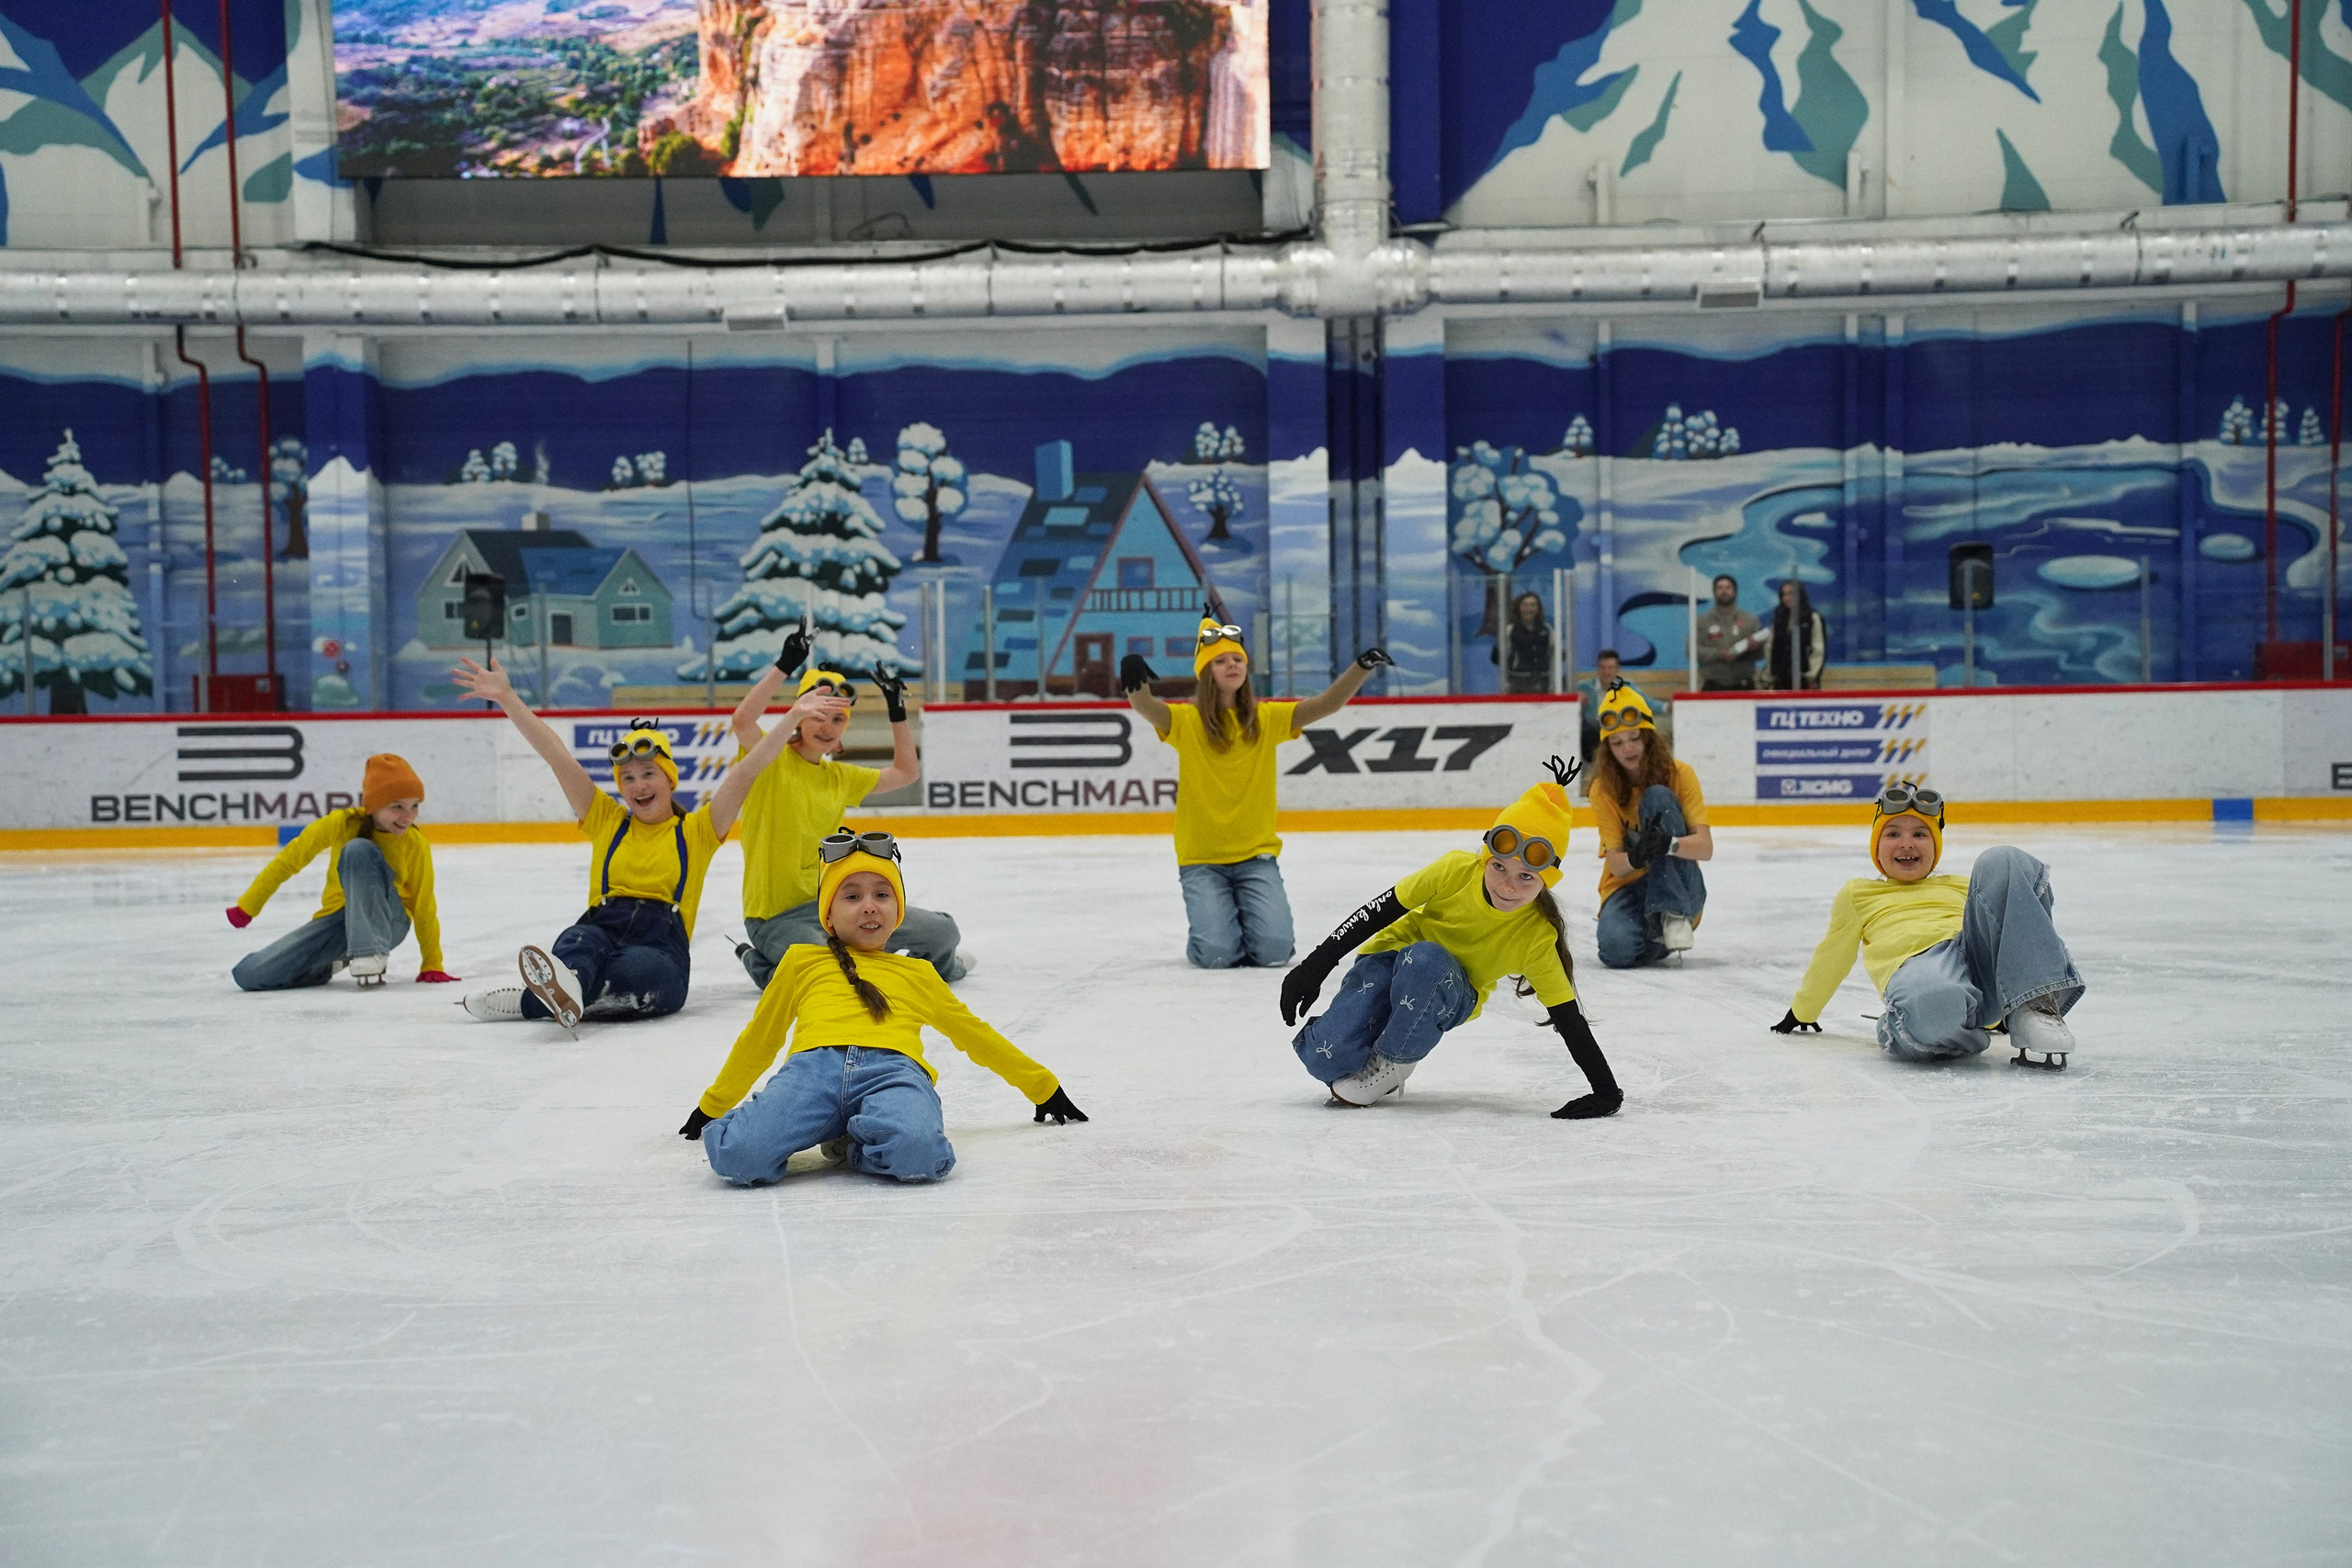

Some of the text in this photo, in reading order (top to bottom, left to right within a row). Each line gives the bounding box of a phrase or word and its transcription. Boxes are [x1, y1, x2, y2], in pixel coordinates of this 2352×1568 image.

[1798, 710, 1865, 728] ТЕХНО
[1283, 724, 1514, 775] X17
[91, 792, 363, 822] BENCHMAR
[928, 779, 1178, 808] BENCHMAR
[1330, 890, 1393, 941] only knives
